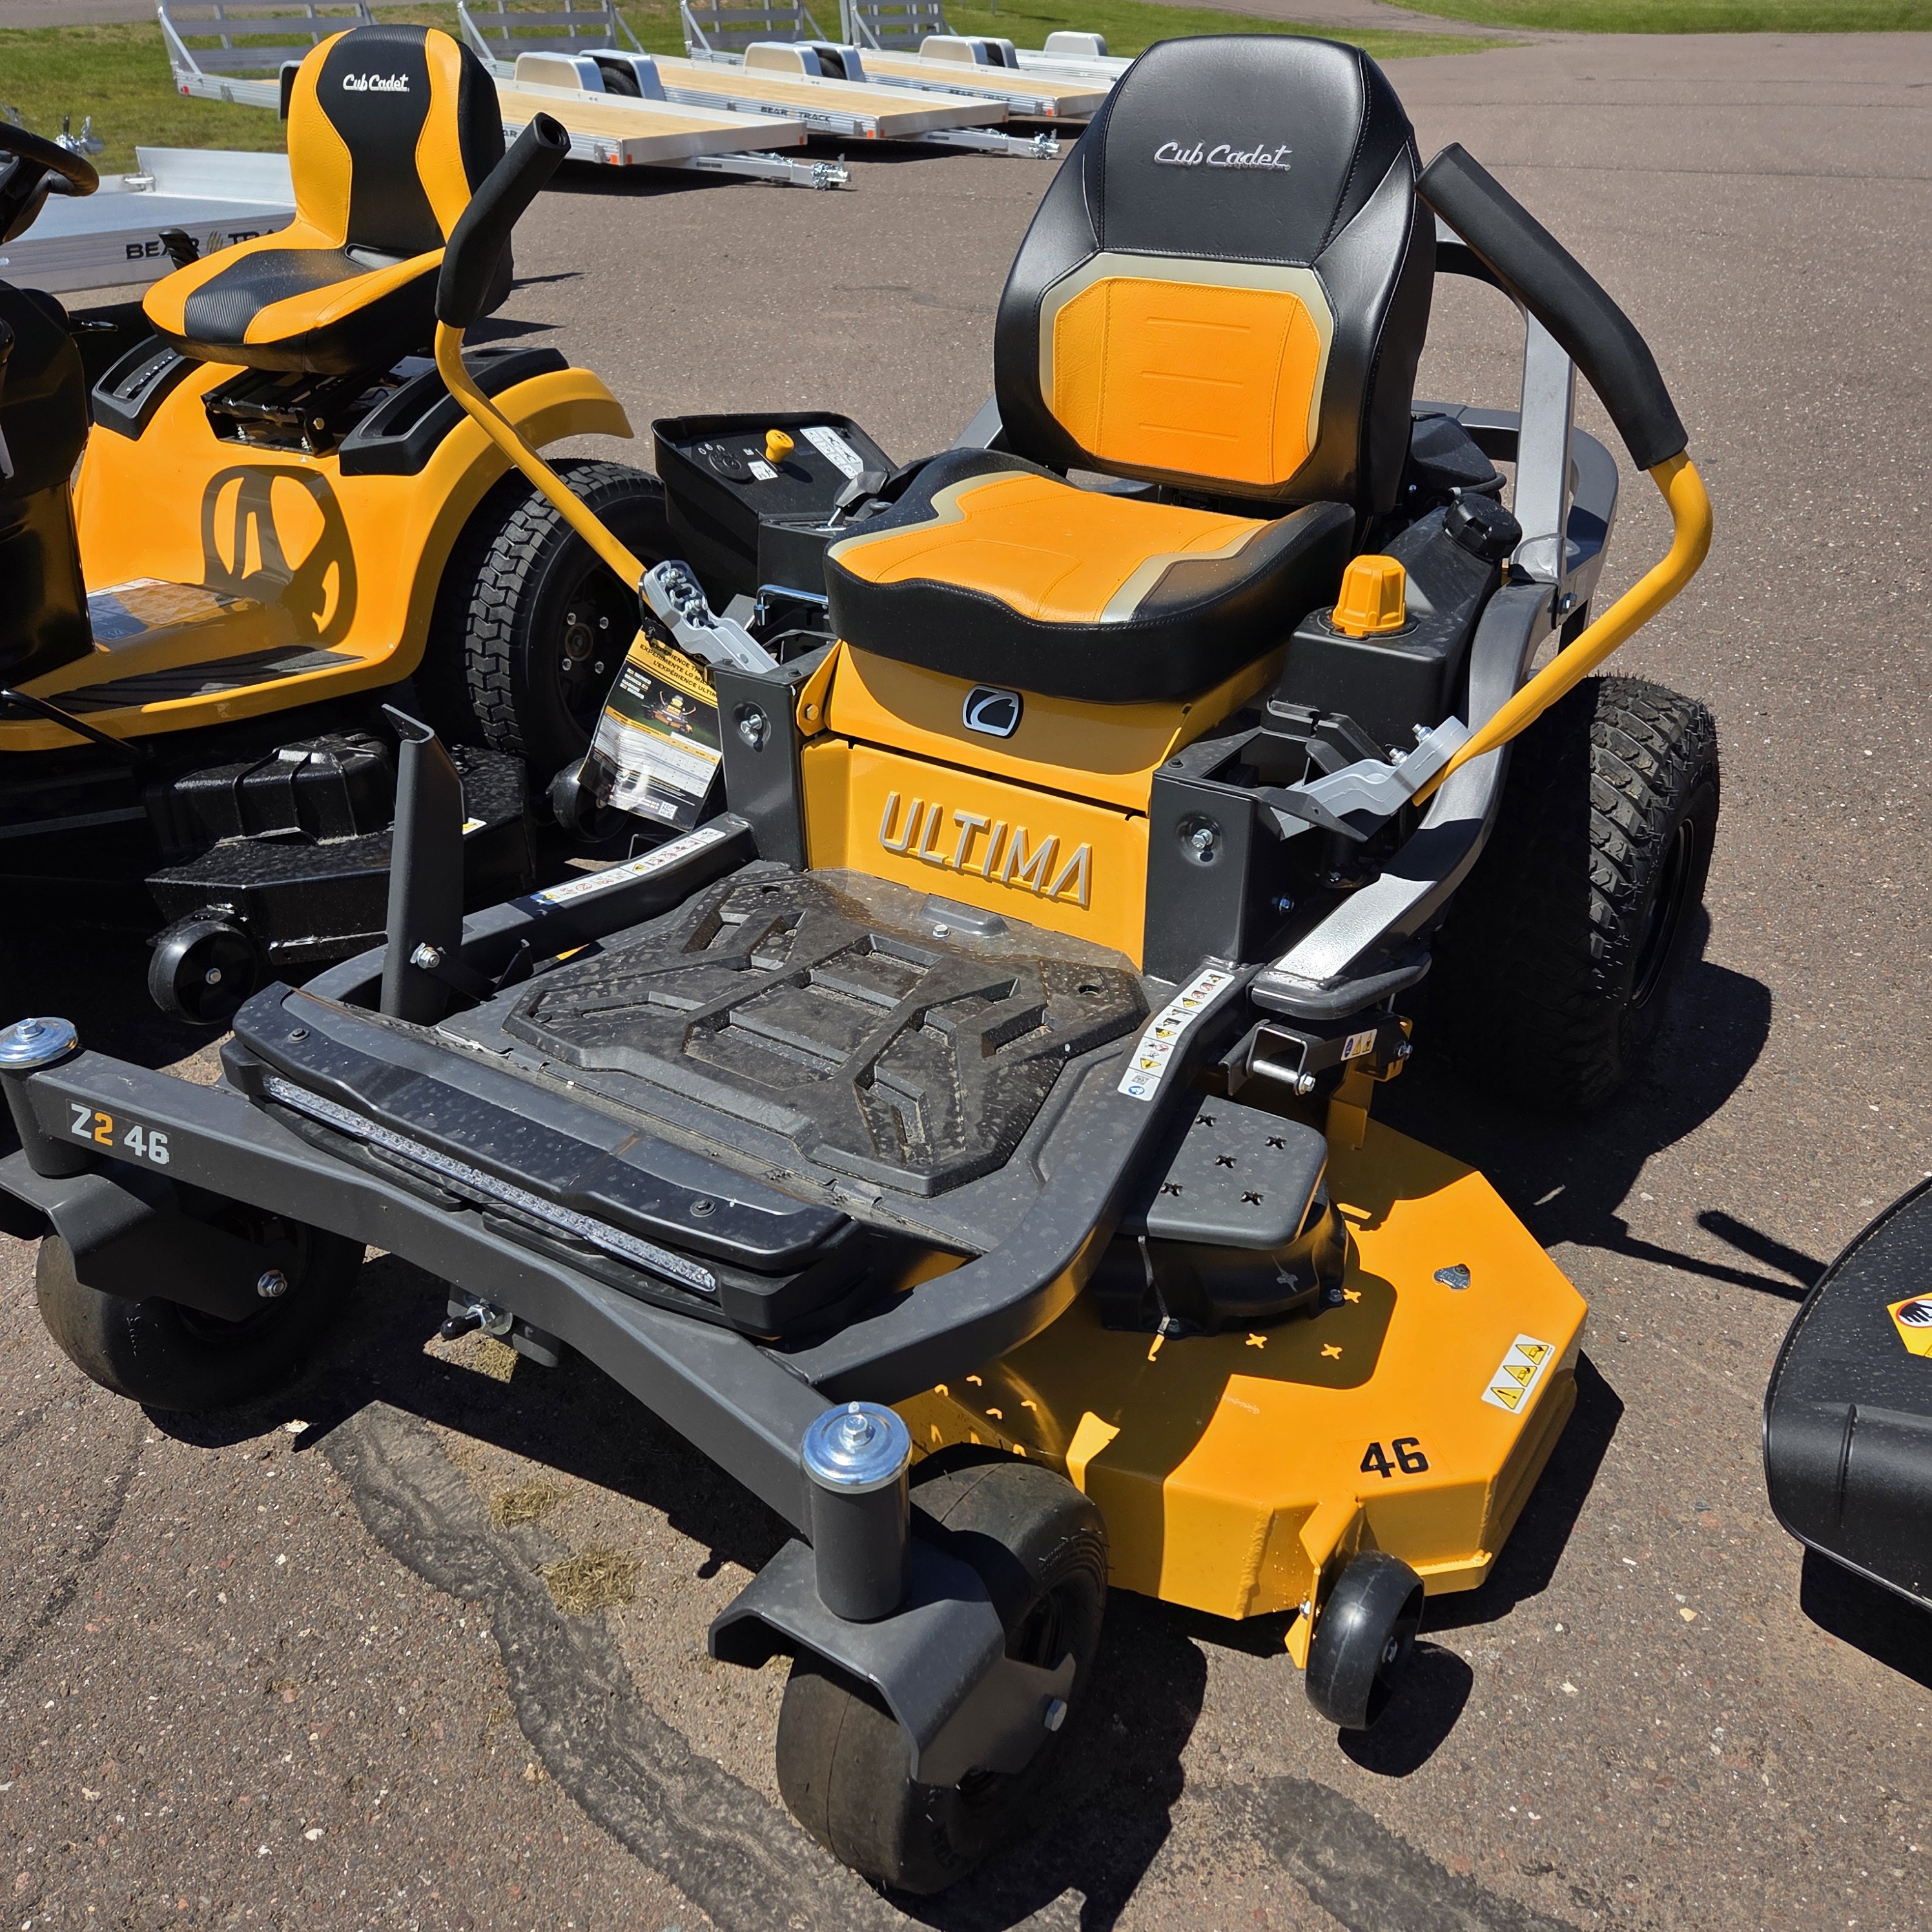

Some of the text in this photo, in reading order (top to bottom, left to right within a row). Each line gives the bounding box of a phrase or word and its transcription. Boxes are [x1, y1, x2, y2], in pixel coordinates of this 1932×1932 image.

[343, 73, 408, 92] Cub Cadet
[1154, 141, 1293, 171] Cub Cadet
[879, 791, 1093, 911] ULTIMA
[71, 1103, 170, 1165] Z2 46
[1360, 1437, 1430, 1479] 46
